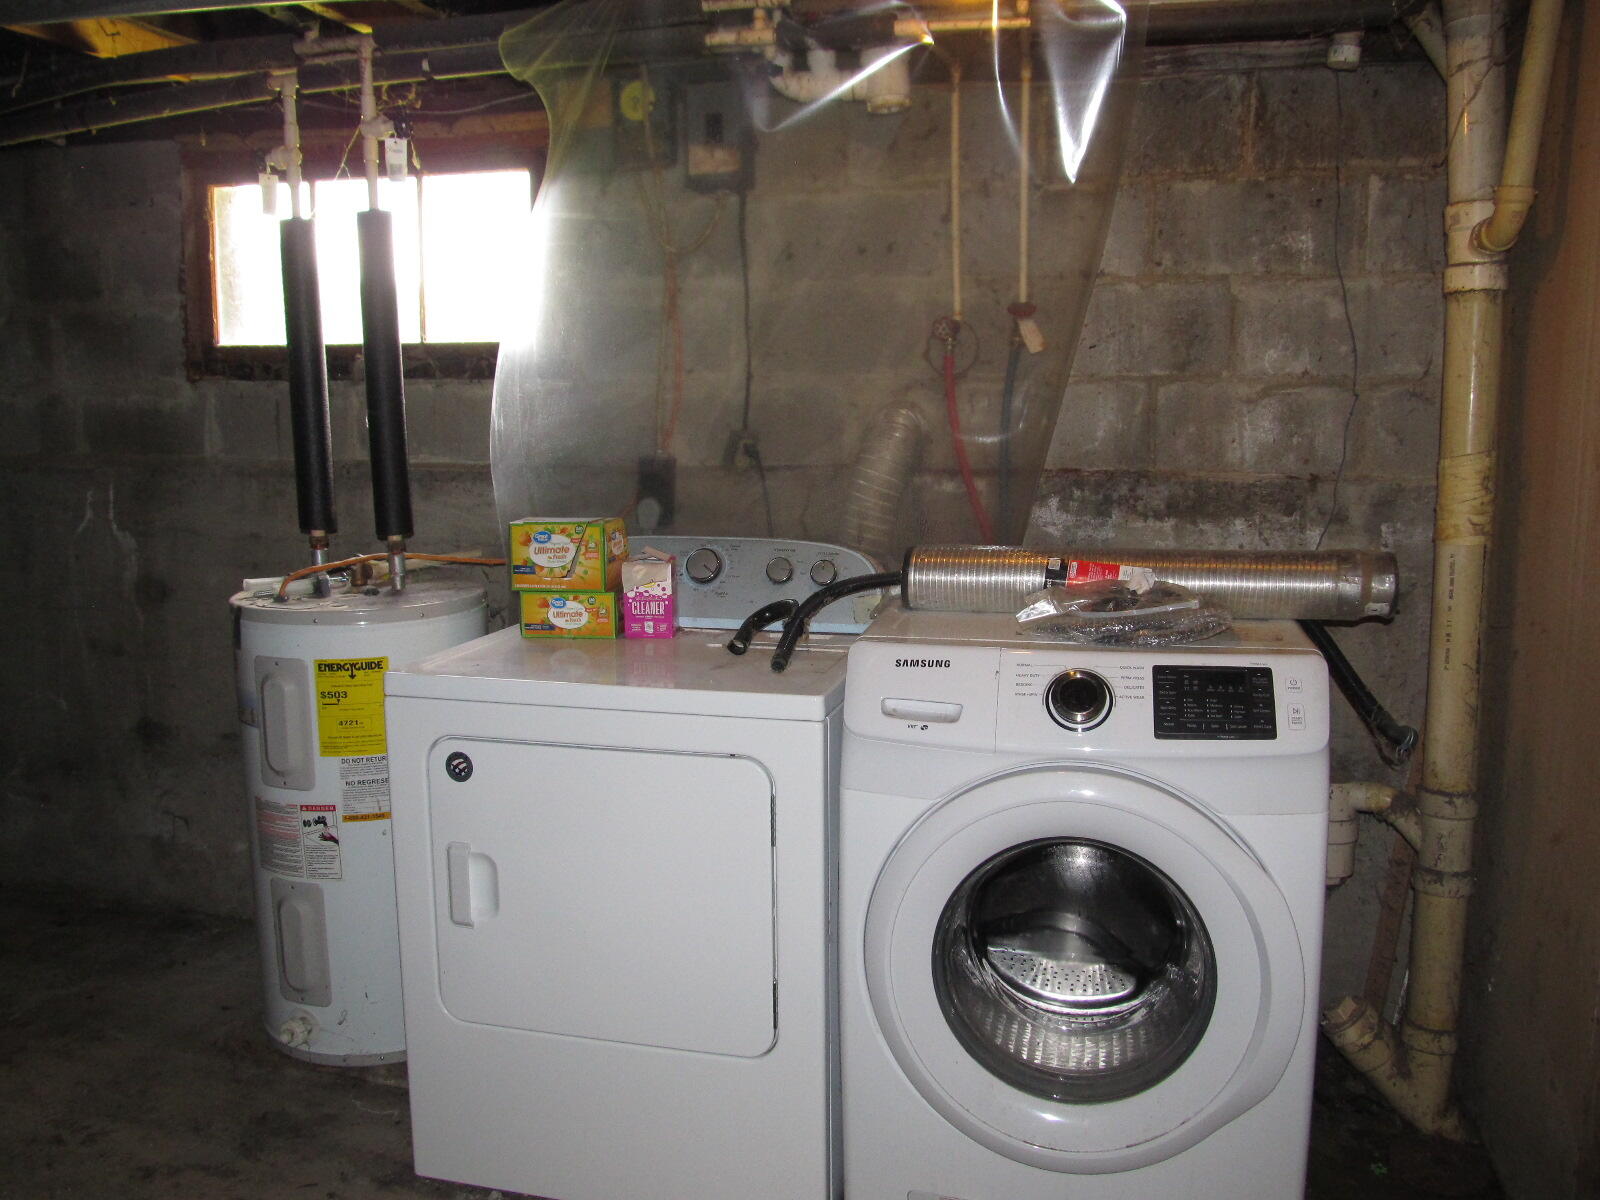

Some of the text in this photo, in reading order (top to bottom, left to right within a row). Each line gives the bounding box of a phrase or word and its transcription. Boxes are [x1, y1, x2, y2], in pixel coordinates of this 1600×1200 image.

[534, 545, 570, 556] Ultimate
[631, 601, 665, 615] CLEANER
[552, 610, 583, 619] Ultimate
[317, 661, 384, 672] ENERGYGUIDE
[895, 659, 951, 668] SAMSUNG
